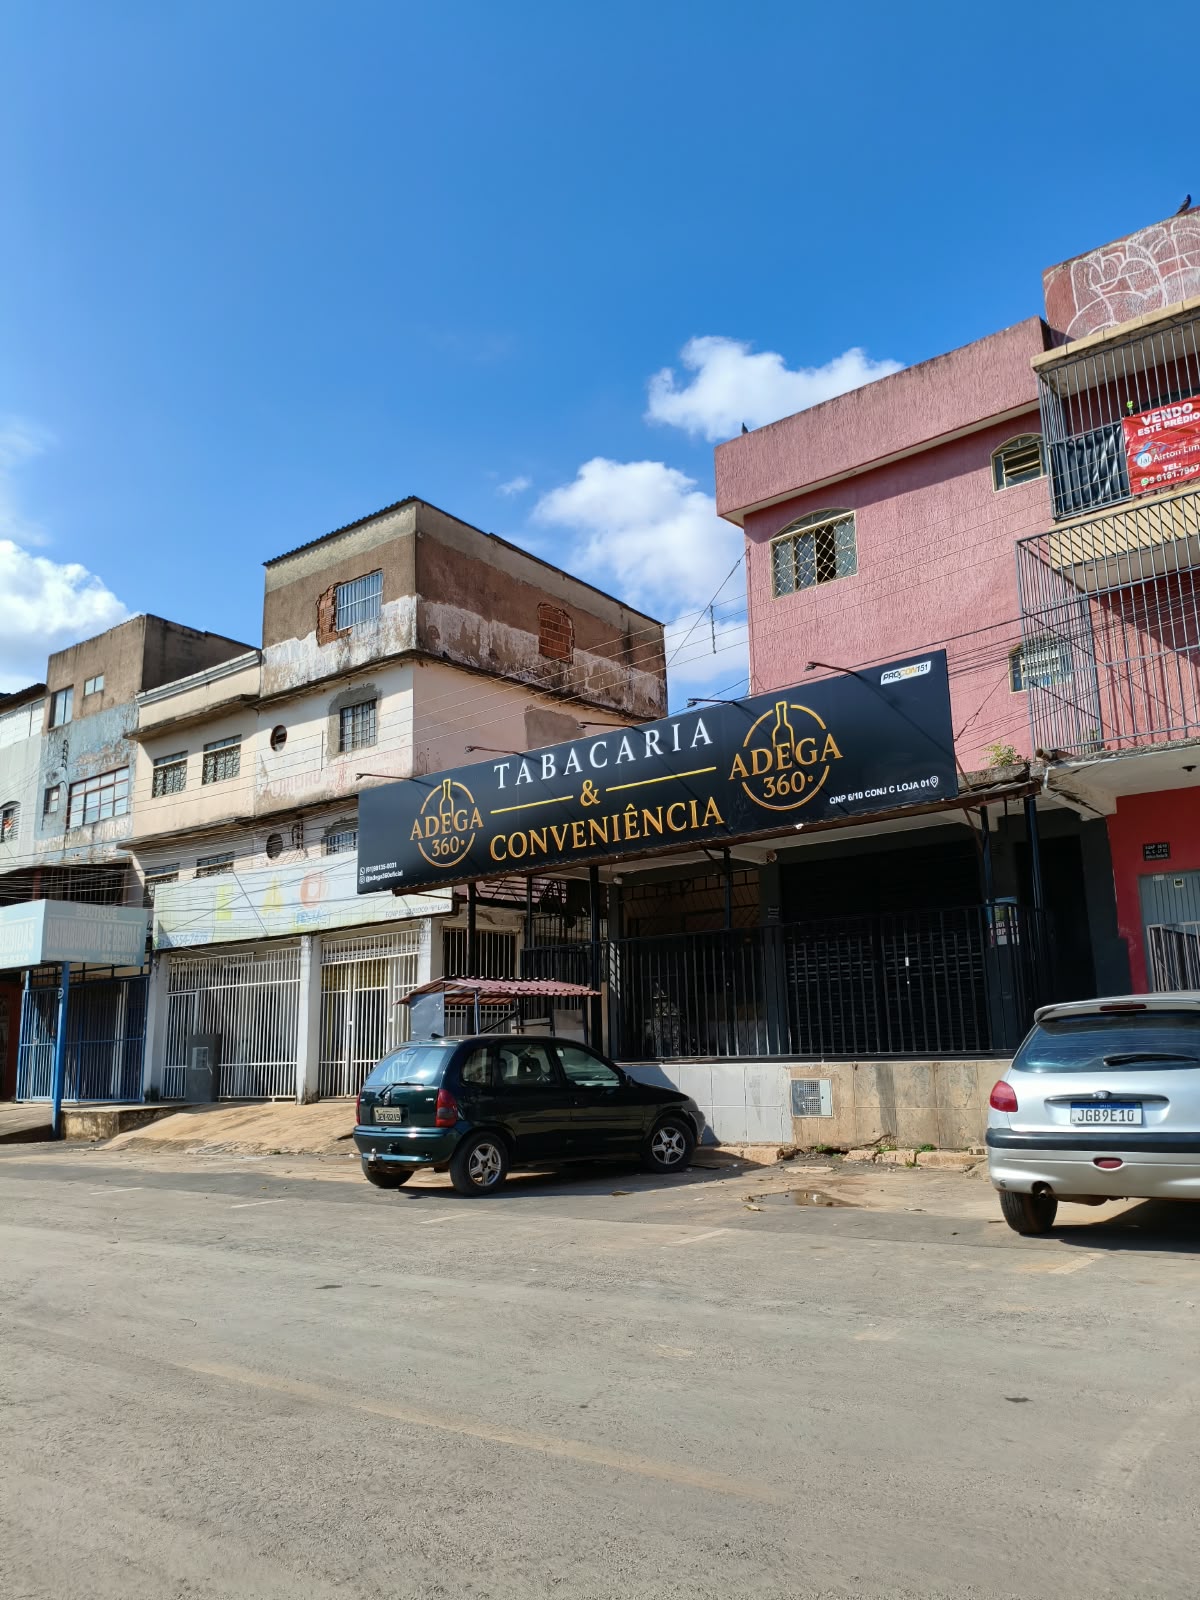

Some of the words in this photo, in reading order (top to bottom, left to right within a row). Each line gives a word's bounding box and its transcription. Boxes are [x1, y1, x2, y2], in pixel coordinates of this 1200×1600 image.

[1141, 402, 1193, 426] VENDO
[1137, 423, 1162, 436] ESTE
[1162, 462, 1182, 472] TEL:
[494, 717, 713, 790] TABACARIA
[728, 733, 844, 781] ADEGA
[579, 779, 601, 807] &
[829, 795, 847, 804] QNP
[848, 791, 863, 801] 6/10
[865, 787, 887, 798] CONJ
[889, 785, 896, 793] C
[897, 781, 919, 792] LOJA
[920, 779, 930, 788] 01
[409, 806, 484, 841] ADEGA
[489, 796, 725, 862] CONVENIÊNCIA
[75, 904, 118, 920] BOUTIQUE
[1077, 1109, 1135, 1122] JGB9E10
